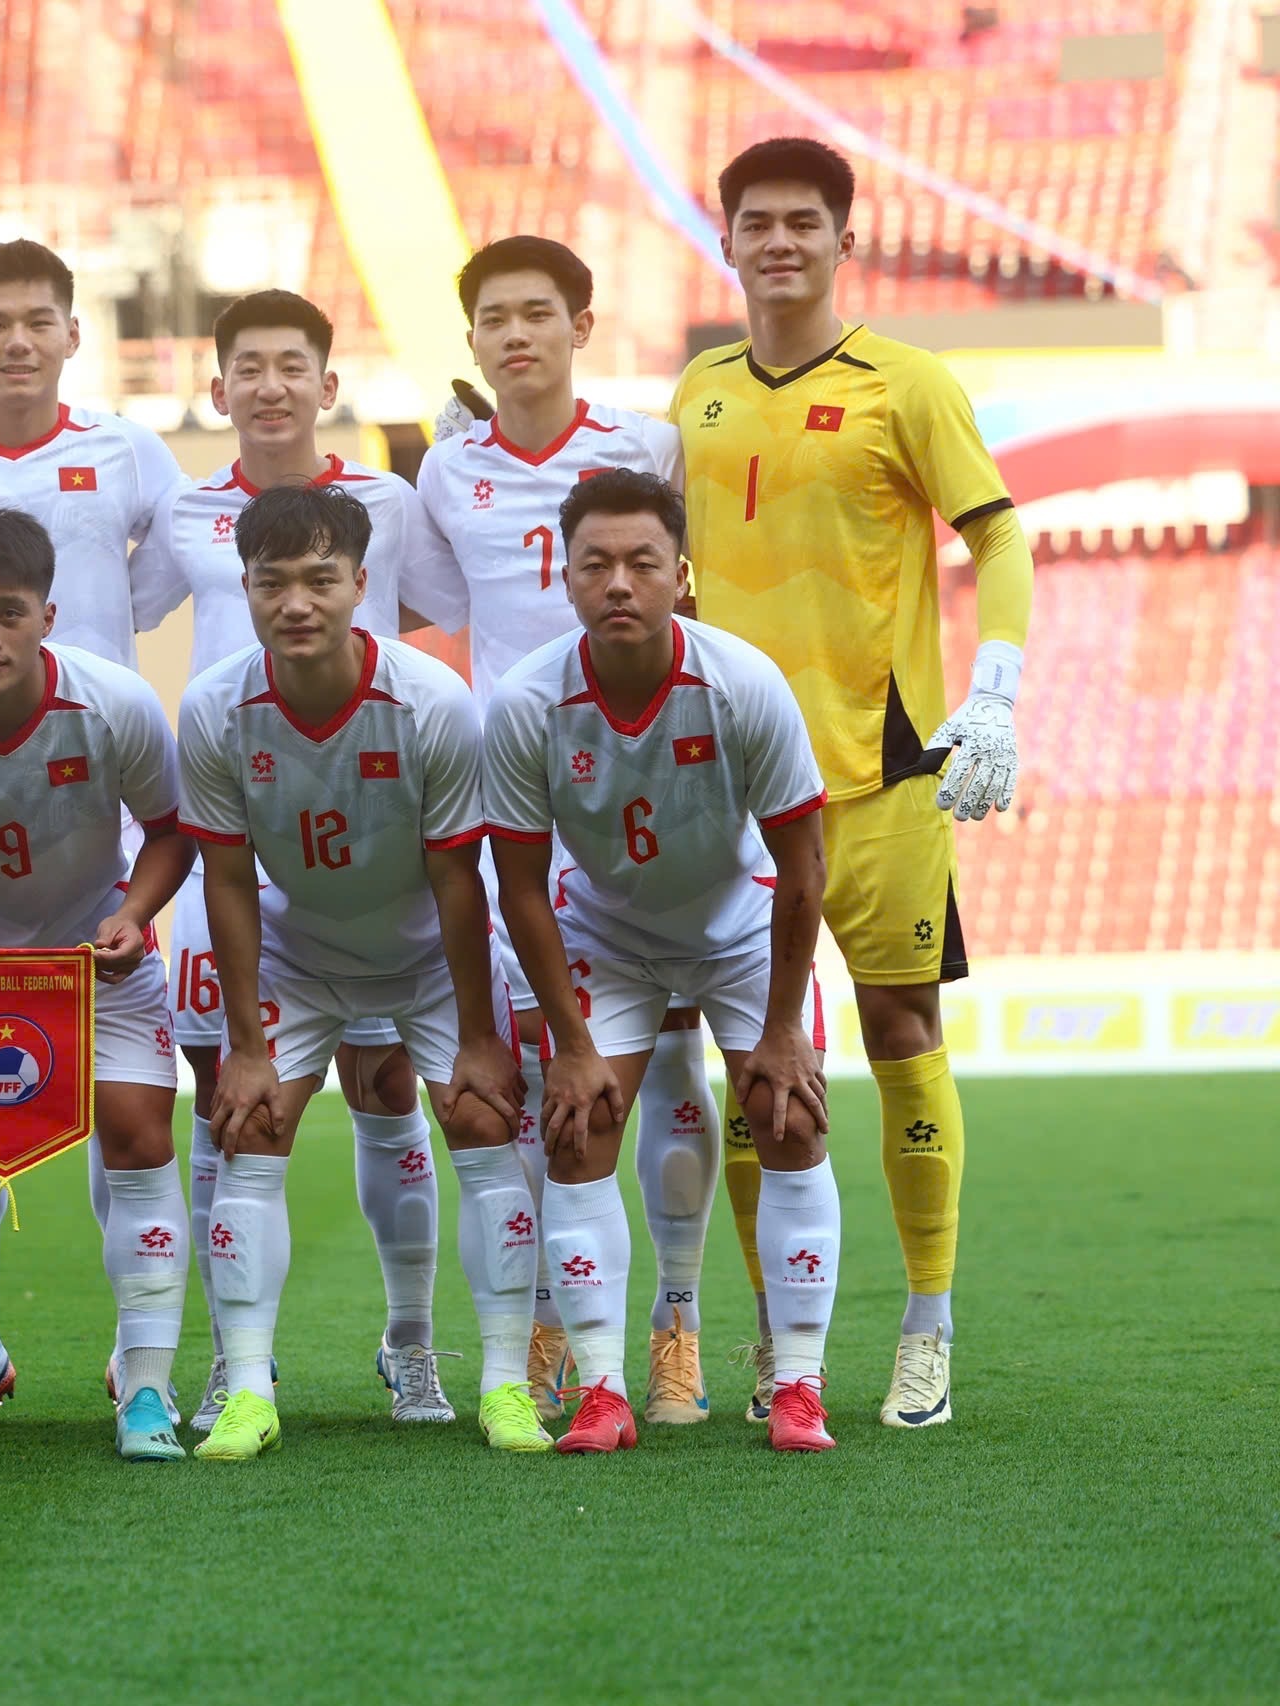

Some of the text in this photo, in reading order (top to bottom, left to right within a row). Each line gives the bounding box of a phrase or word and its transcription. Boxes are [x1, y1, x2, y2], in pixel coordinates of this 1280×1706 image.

[745, 454, 759, 522] 1
[523, 525, 553, 590] 7
[299, 809, 352, 870] 12
[623, 796, 659, 865] 6
[23, 975, 74, 991] FEDERATION
[177, 945, 221, 1015] 16
